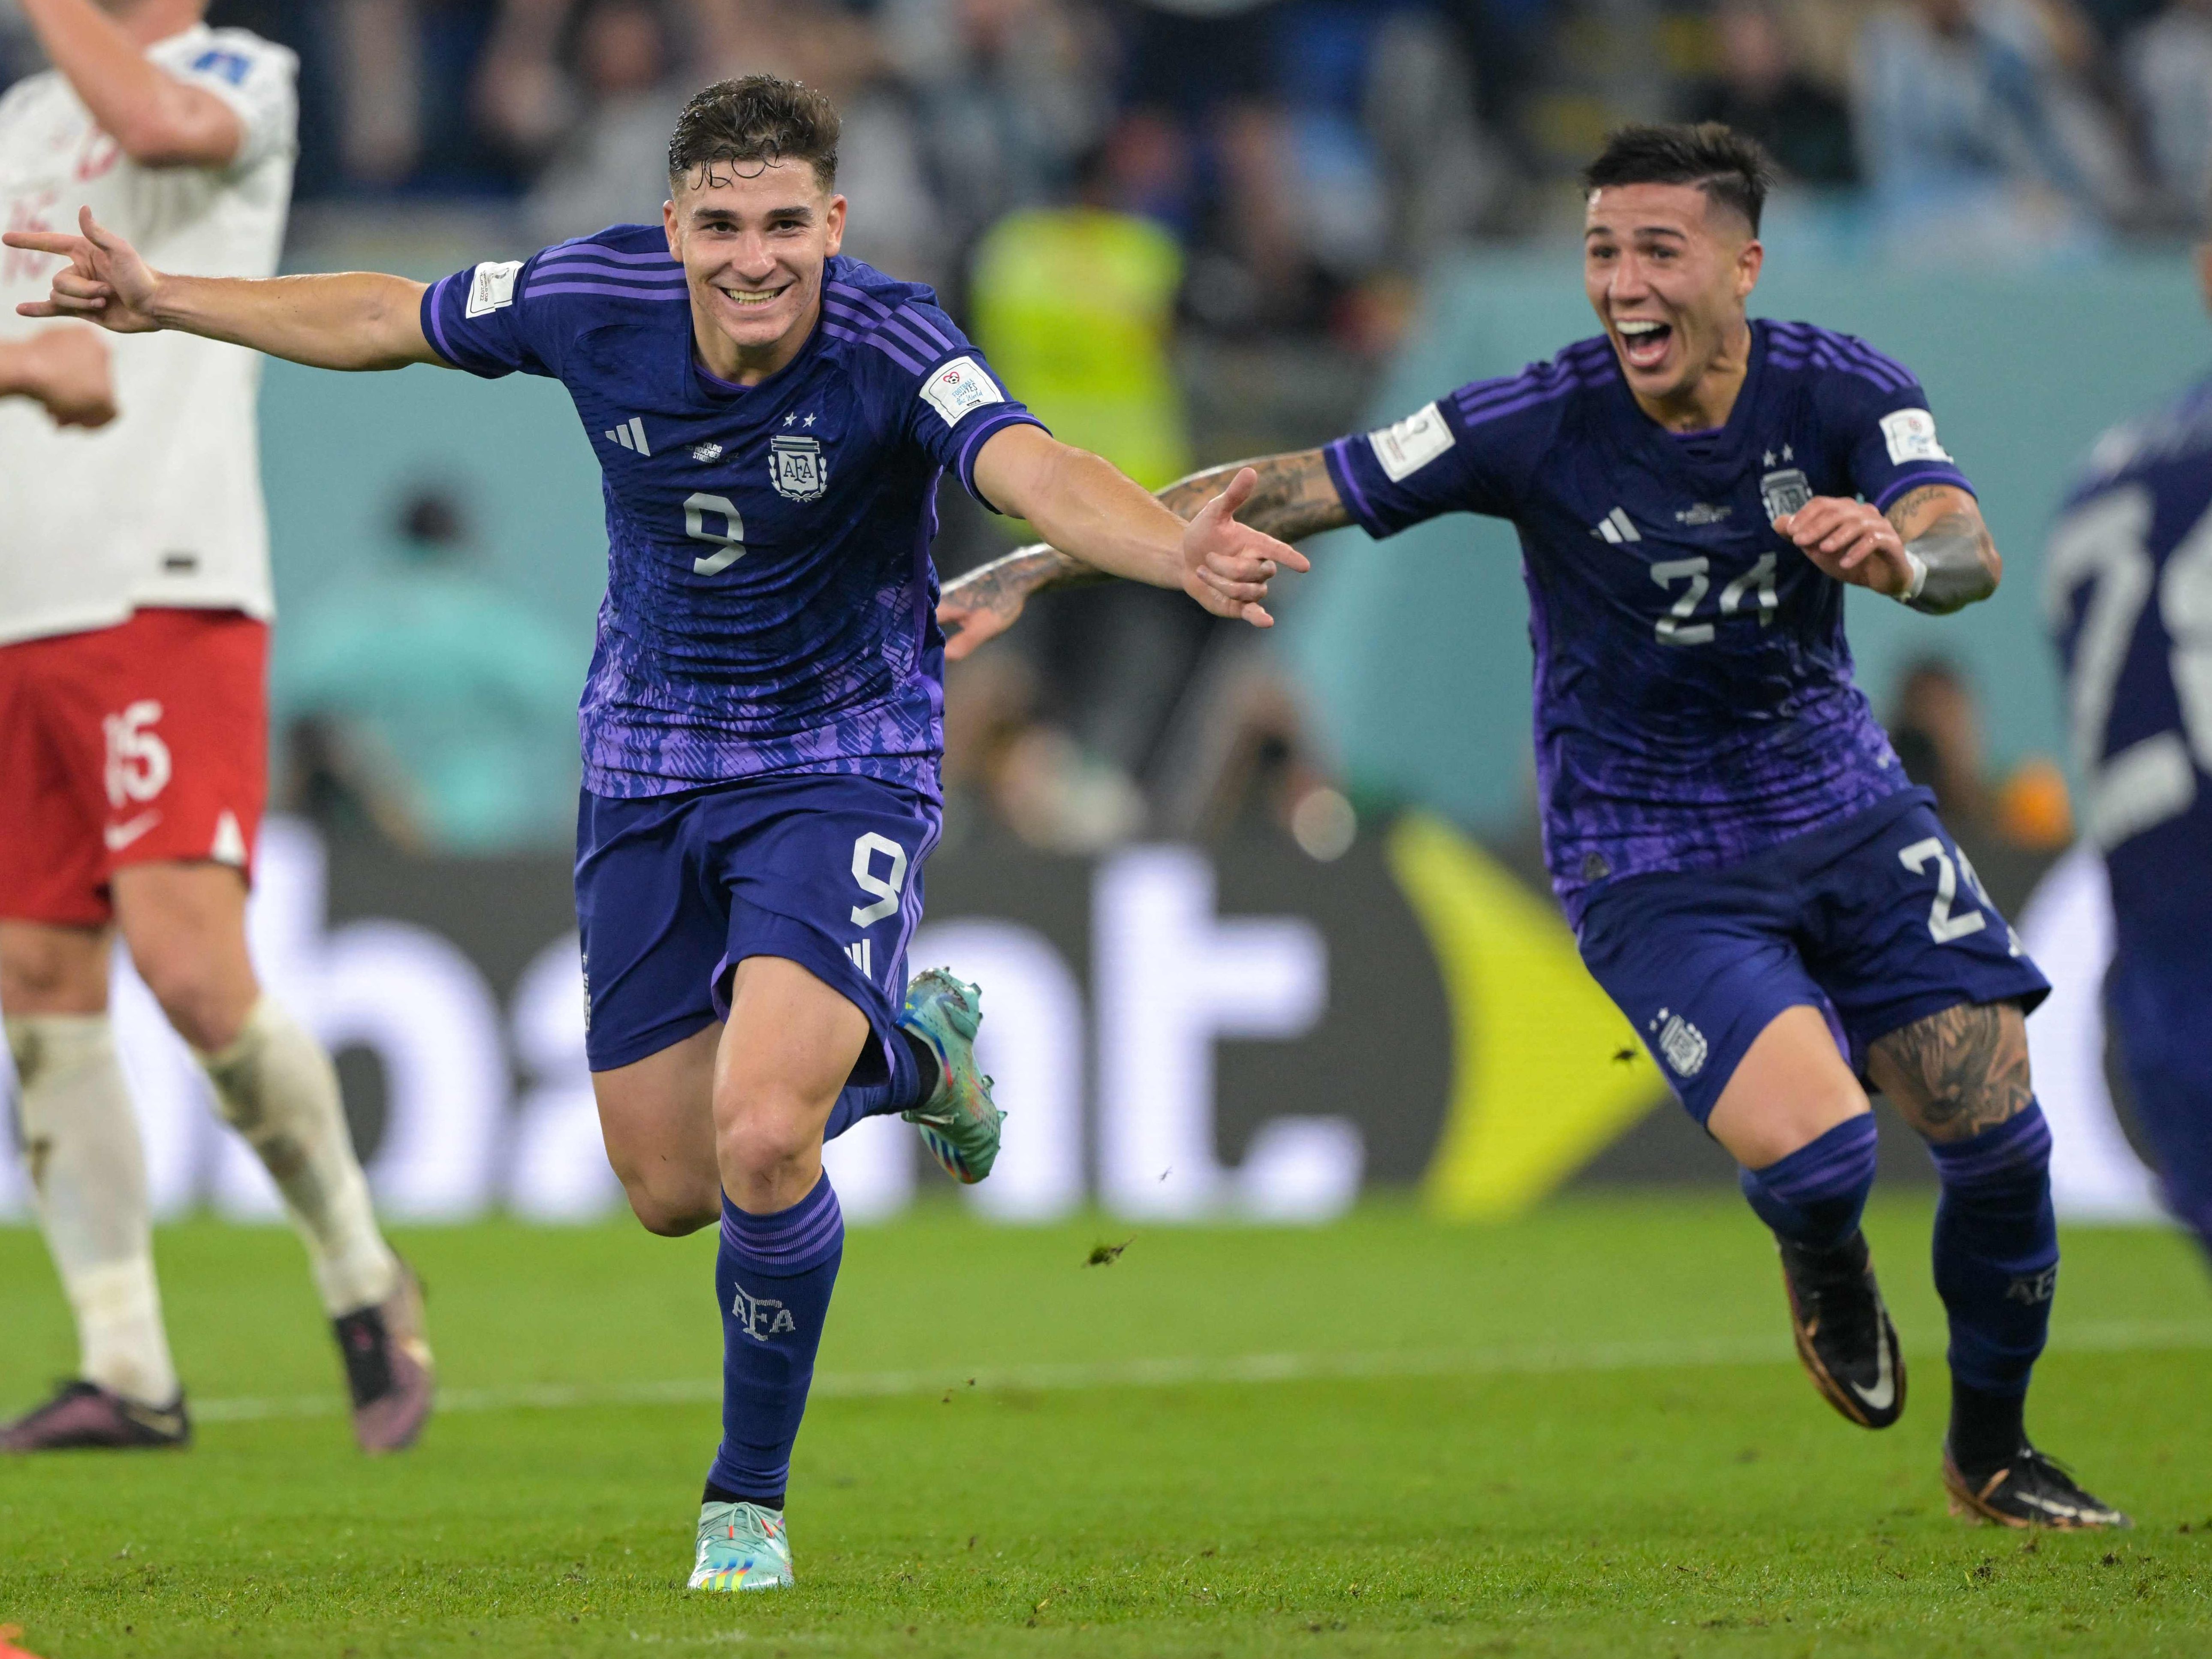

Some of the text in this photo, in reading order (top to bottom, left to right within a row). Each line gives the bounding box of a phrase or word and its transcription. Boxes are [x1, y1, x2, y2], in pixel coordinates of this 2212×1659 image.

[695, 446, 721, 459] NOVEMBER
[703, 442, 722, 453] POLAND
[783, 453, 814, 484] AFA
[683, 492, 747, 577] 9
[1650, 552, 1779, 646] 24
[102, 699, 172, 809] 15
[851, 831, 907, 929] 9
[732, 1281, 796, 1342] AFA
